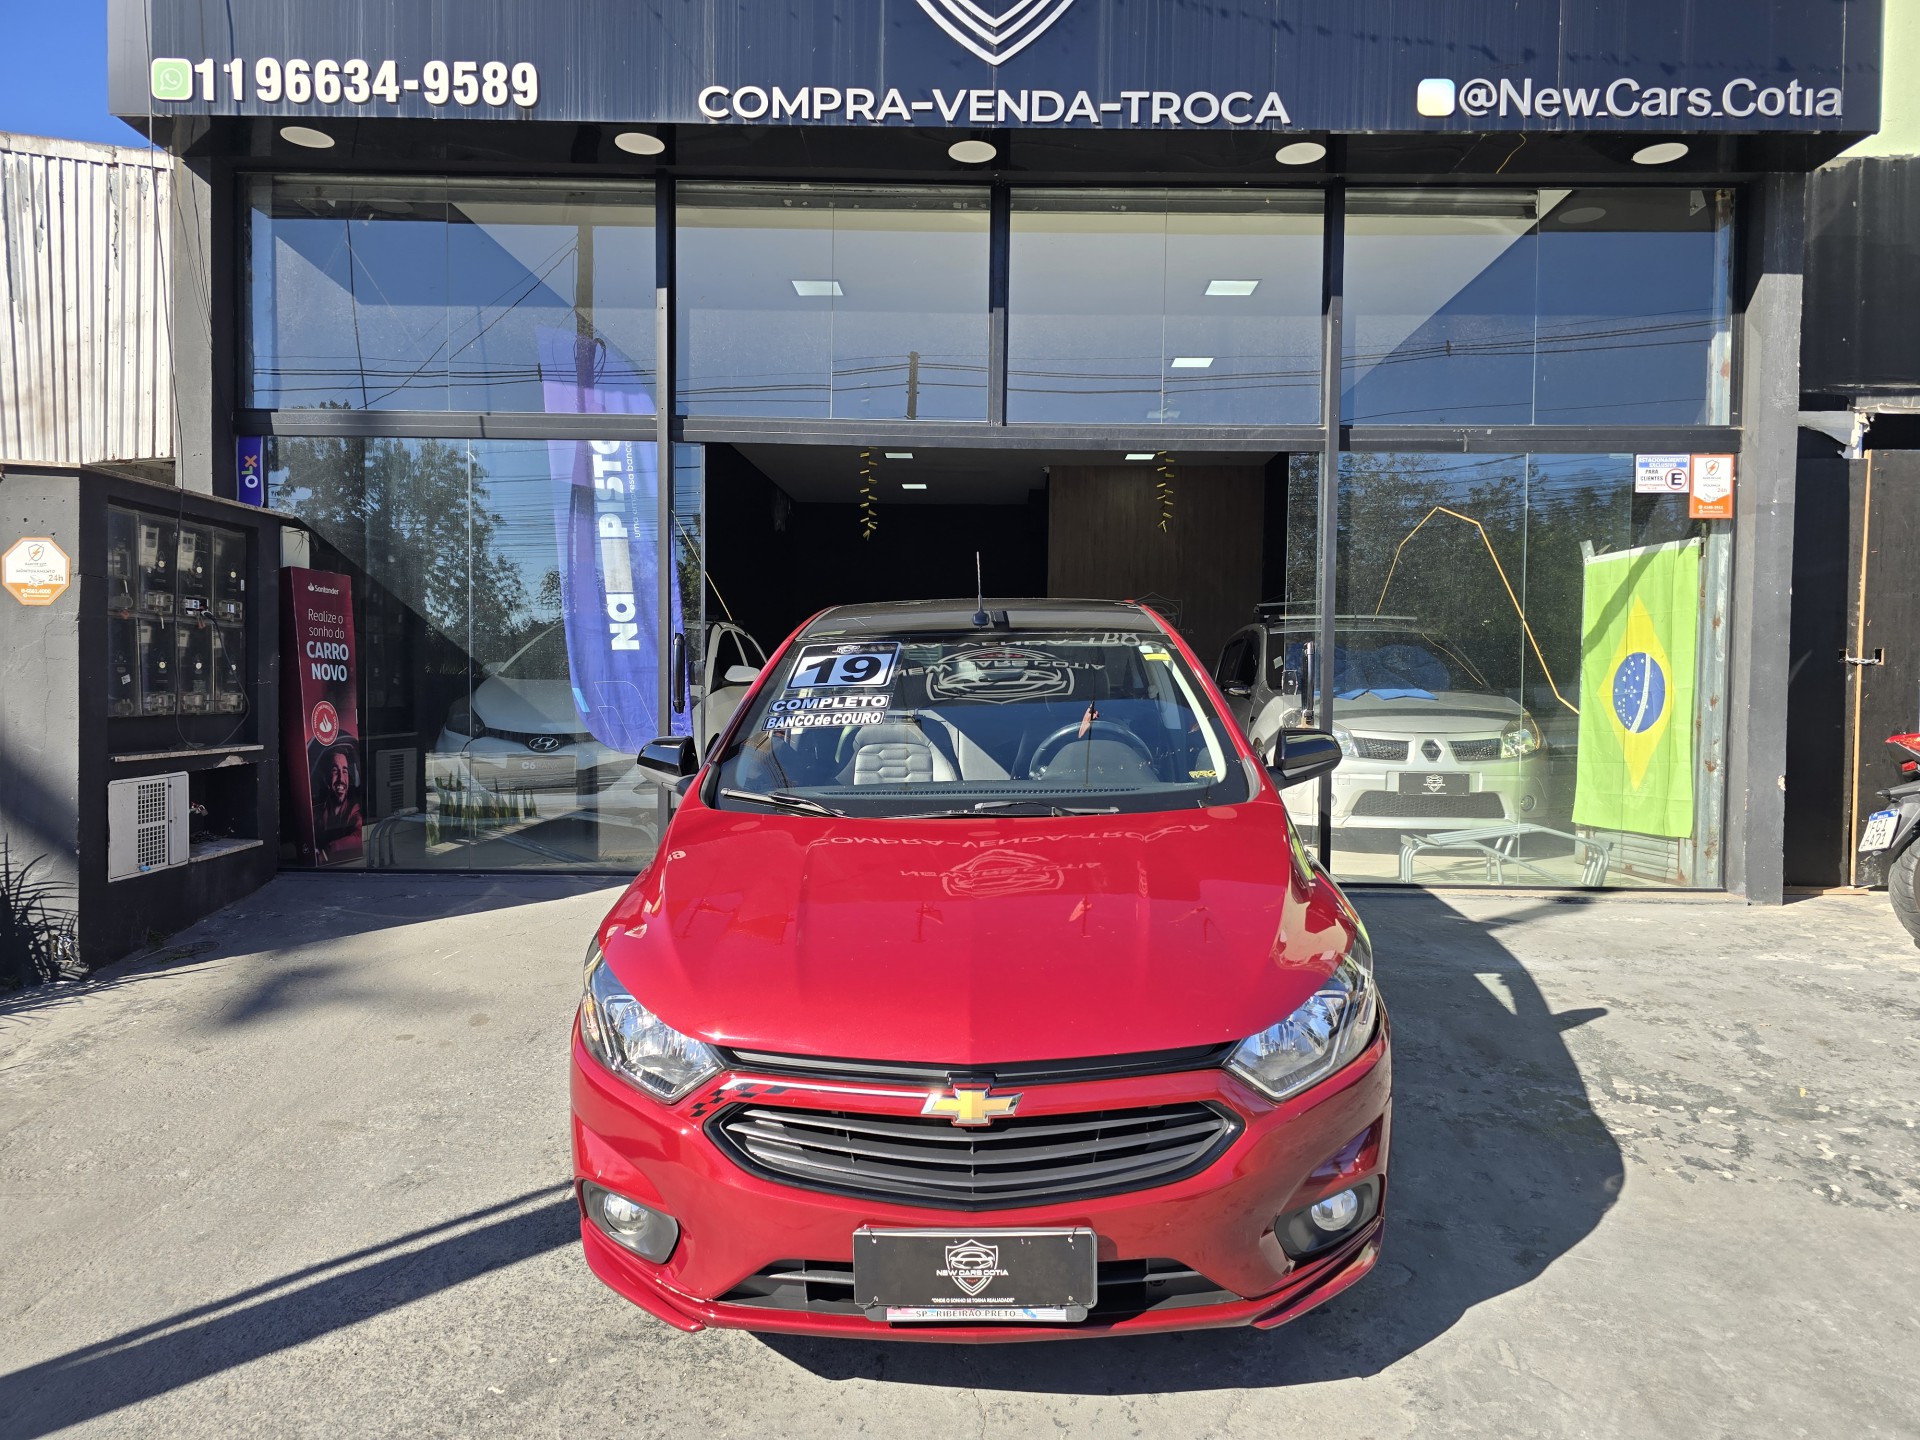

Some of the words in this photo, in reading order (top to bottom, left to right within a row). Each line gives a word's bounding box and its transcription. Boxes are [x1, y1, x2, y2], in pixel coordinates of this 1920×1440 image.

[255, 58, 538, 106] 96634-9589
[241, 455, 258, 488] OLX
[1671, 472, 1682, 485] E
[628, 474, 638, 514] empresa
[633, 517, 641, 538] uma
[48, 574, 64, 582] 24h
[314, 584, 339, 595] Santander
[308, 608, 336, 624] Realize
[338, 615, 344, 624] o
[308, 626, 334, 638] sonho
[335, 627, 345, 639] do
[306, 640, 349, 661] CARRO
[311, 663, 348, 682] NOVO
[805, 656, 882, 684] 19
[771, 695, 888, 711] COMPLETO
[766, 714, 814, 729] BANCO
[815, 714, 830, 725] de
[832, 712, 881, 724] COURO
[521, 761, 536, 770] C6
[916, 1310, 928, 1318] SP
[937, 1308, 982, 1317] RIBEIRÃO
[985, 1309, 1016, 1317] PRETO
